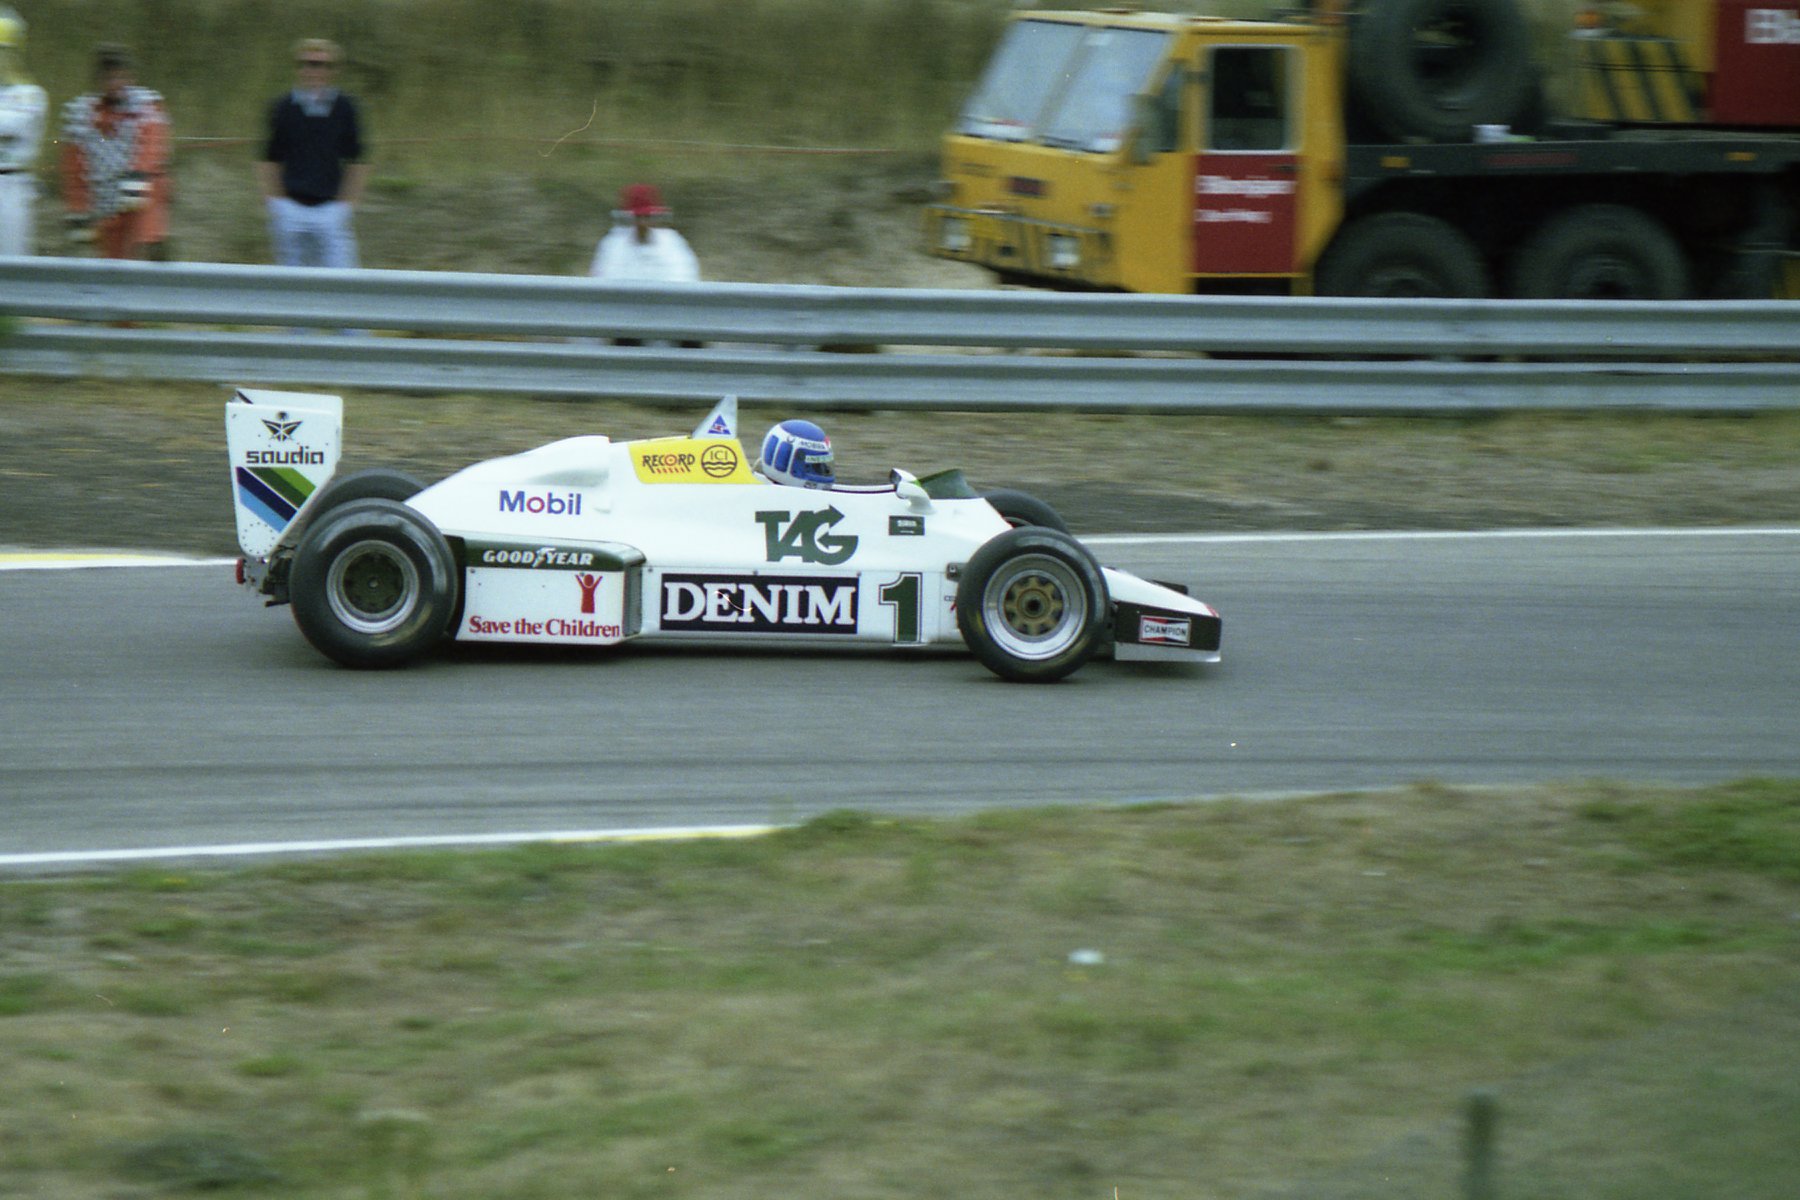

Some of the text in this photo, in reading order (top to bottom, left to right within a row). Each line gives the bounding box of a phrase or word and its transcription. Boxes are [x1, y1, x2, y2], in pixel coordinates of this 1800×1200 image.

[246, 446, 324, 465] saudia
[642, 453, 696, 474] RECORD
[710, 450, 728, 461] ICI
[499, 490, 582, 515] Mobil
[755, 504, 859, 566] TAG
[662, 581, 857, 626] DENIM
[878, 572, 923, 644] 1
[469, 616, 620, 638] Save the Children
[1144, 624, 1187, 637] CHAMPION
